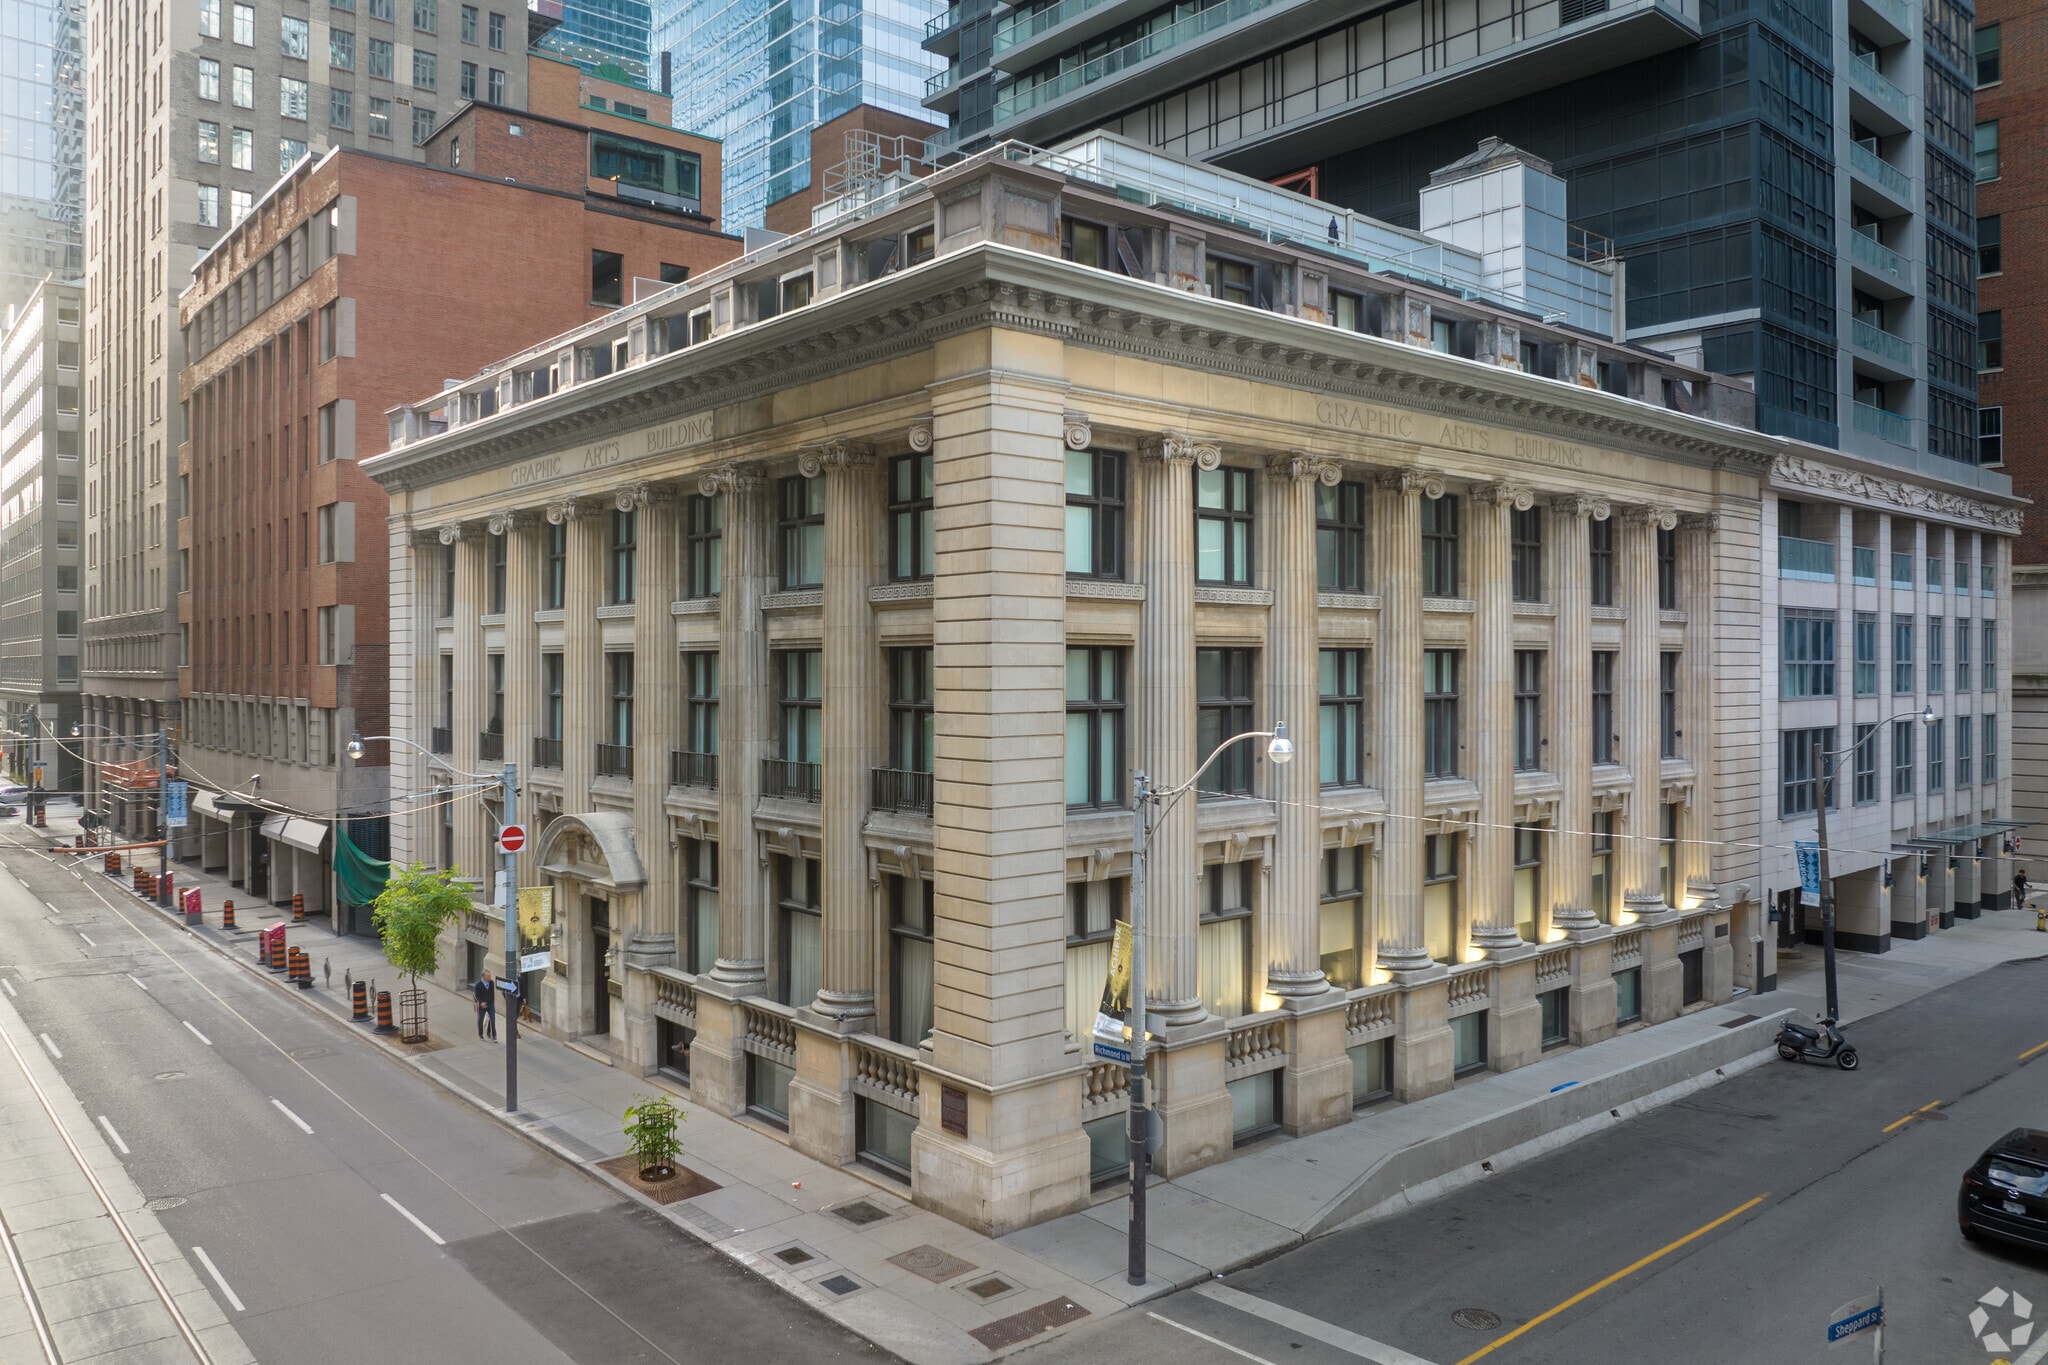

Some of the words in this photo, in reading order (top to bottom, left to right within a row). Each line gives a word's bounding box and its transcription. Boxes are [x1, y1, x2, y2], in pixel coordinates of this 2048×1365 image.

[1315, 400, 1412, 438] GRAPHIC
[1439, 424, 1489, 451] ARTS
[1514, 436, 1583, 468] BUILDING
[511, 457, 561, 485] GRAPHIC
[583, 442, 620, 469] ARTS
[542, 890, 551, 927] ACHIEVE
[1094, 1044, 1120, 1060] Richmond
[1835, 1312, 1870, 1338] Sheppard
[1871, 1312, 1878, 1322] St
